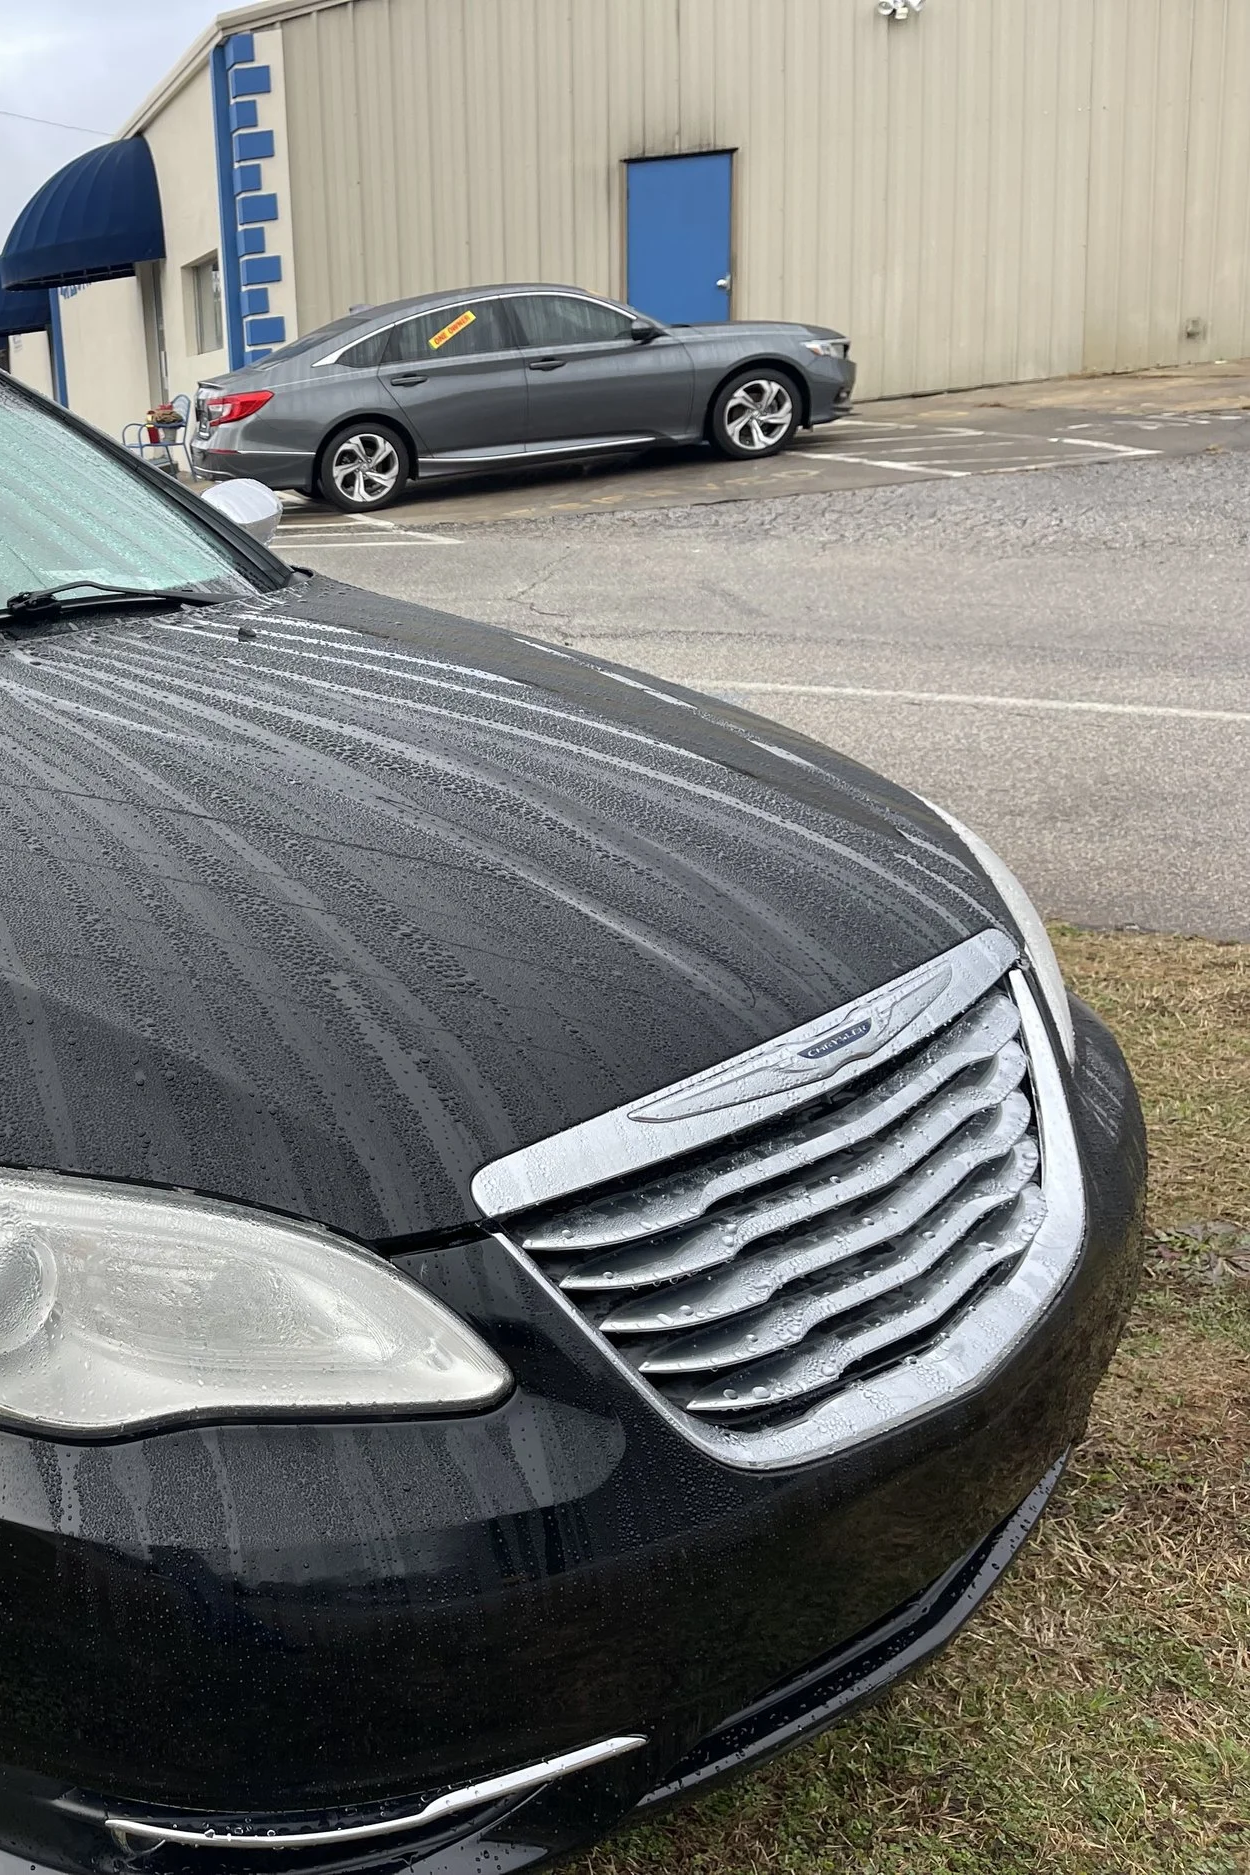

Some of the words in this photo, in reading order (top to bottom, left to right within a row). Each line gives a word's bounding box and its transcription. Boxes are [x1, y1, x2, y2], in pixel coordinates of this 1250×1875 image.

[433, 332, 447, 345] ONE
[447, 314, 471, 334] OWNER
[808, 1025, 867, 1056] CHRYSLER
